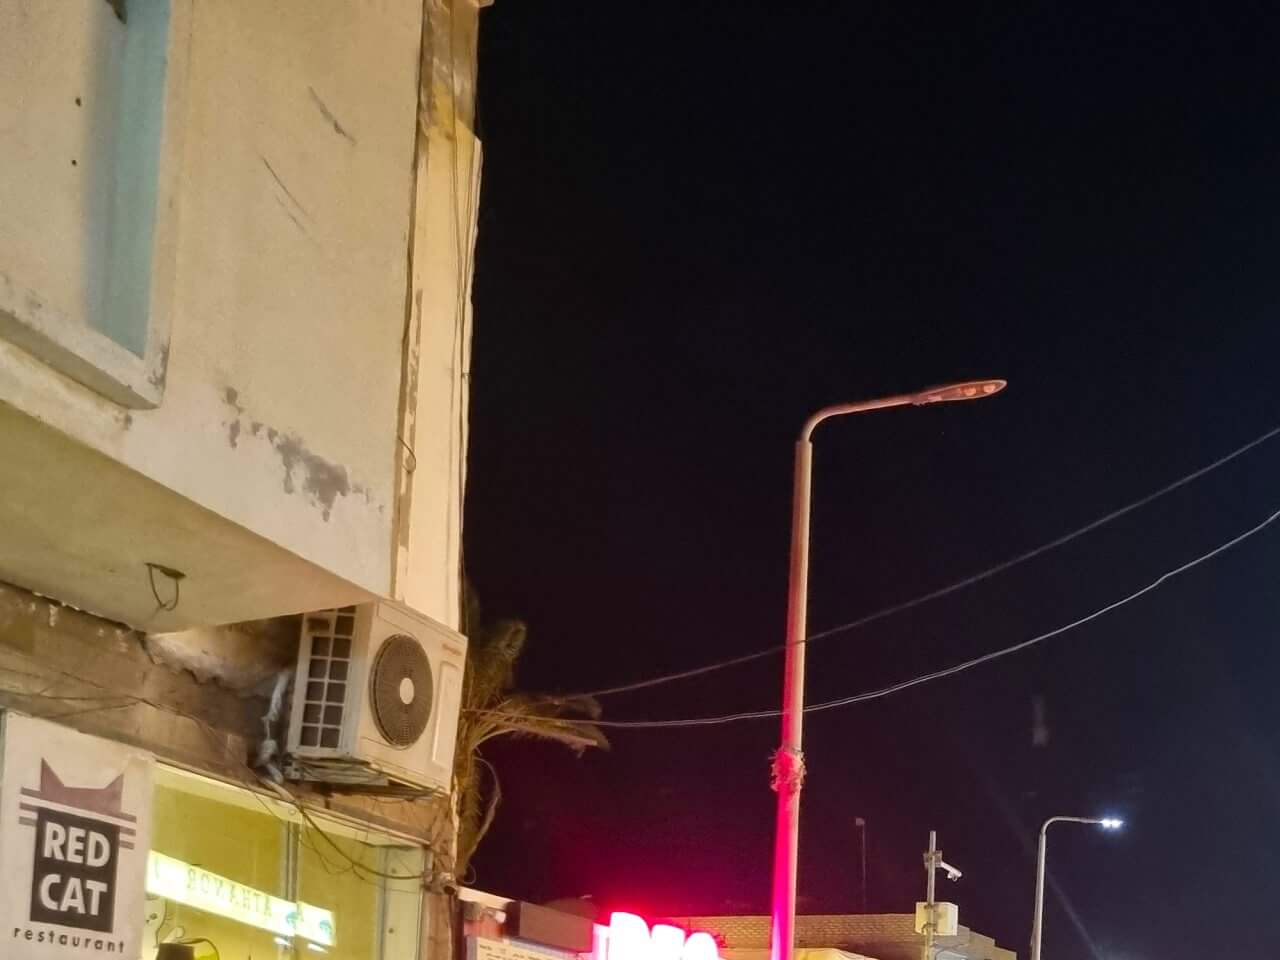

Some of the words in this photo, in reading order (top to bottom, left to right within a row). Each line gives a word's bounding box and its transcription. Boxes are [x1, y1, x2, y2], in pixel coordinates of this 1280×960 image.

[43, 821, 111, 867] RED
[38, 873, 108, 916] CAT
[13, 926, 125, 953] restaurant
